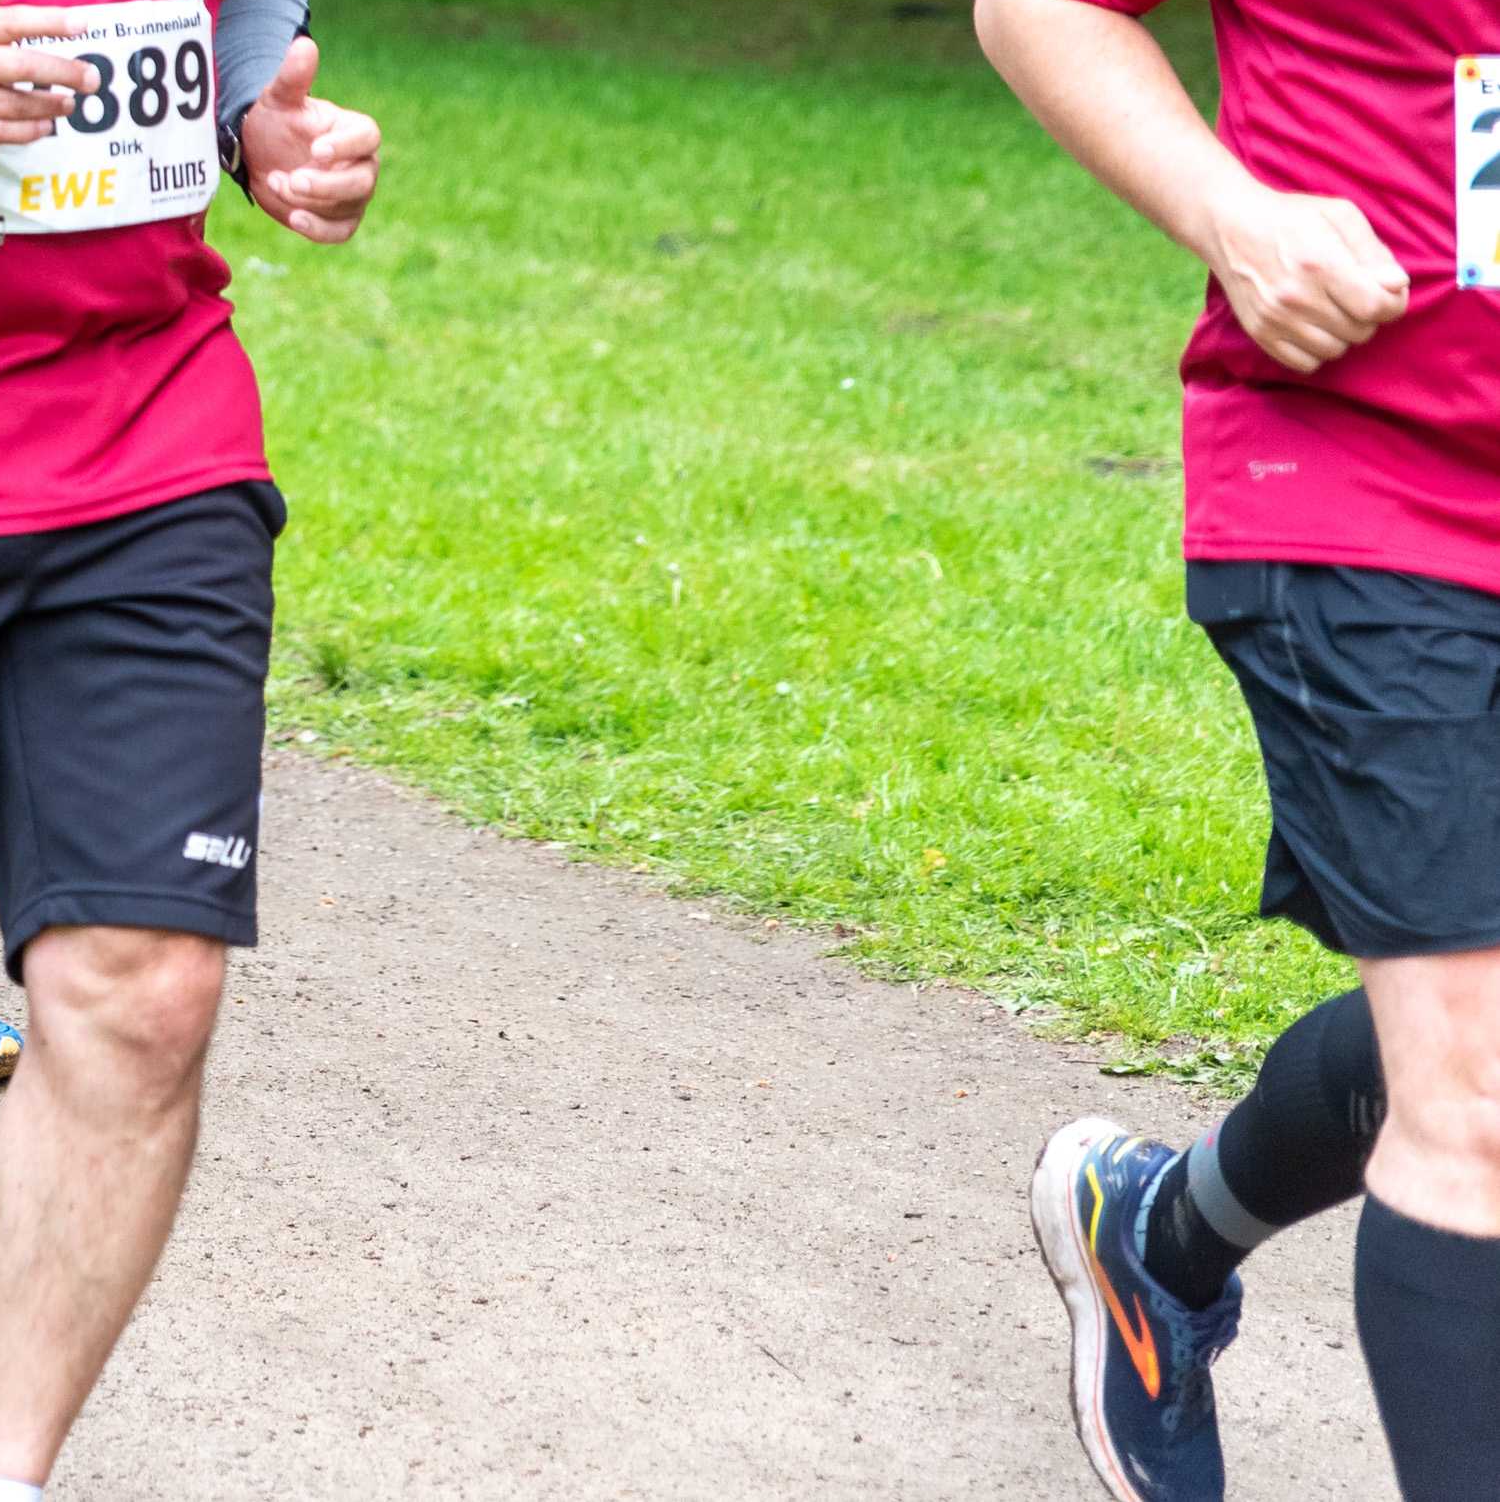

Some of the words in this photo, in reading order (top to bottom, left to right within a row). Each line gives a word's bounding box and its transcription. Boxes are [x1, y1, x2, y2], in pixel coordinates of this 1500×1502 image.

[32, 39, 210, 137] 889
[109, 139, 143, 157] Dirk
[19, 168, 117, 213] EWE
[149, 158, 206, 192] bruns
